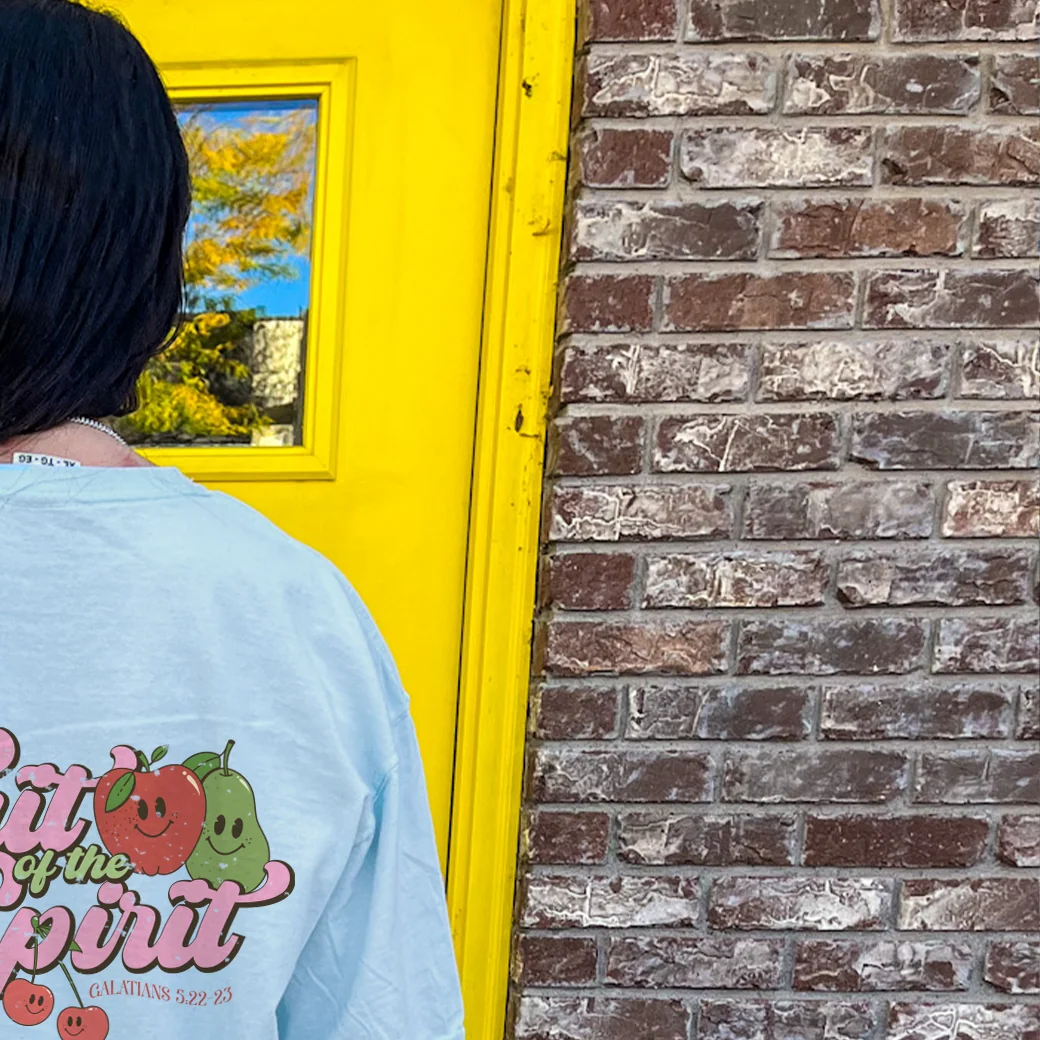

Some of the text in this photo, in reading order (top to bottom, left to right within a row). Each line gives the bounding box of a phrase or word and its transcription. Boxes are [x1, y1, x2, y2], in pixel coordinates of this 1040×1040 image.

[18, 454, 32, 463] EG
[12, 844, 135, 898] of the
[89, 979, 171, 1002] GALATIANS
